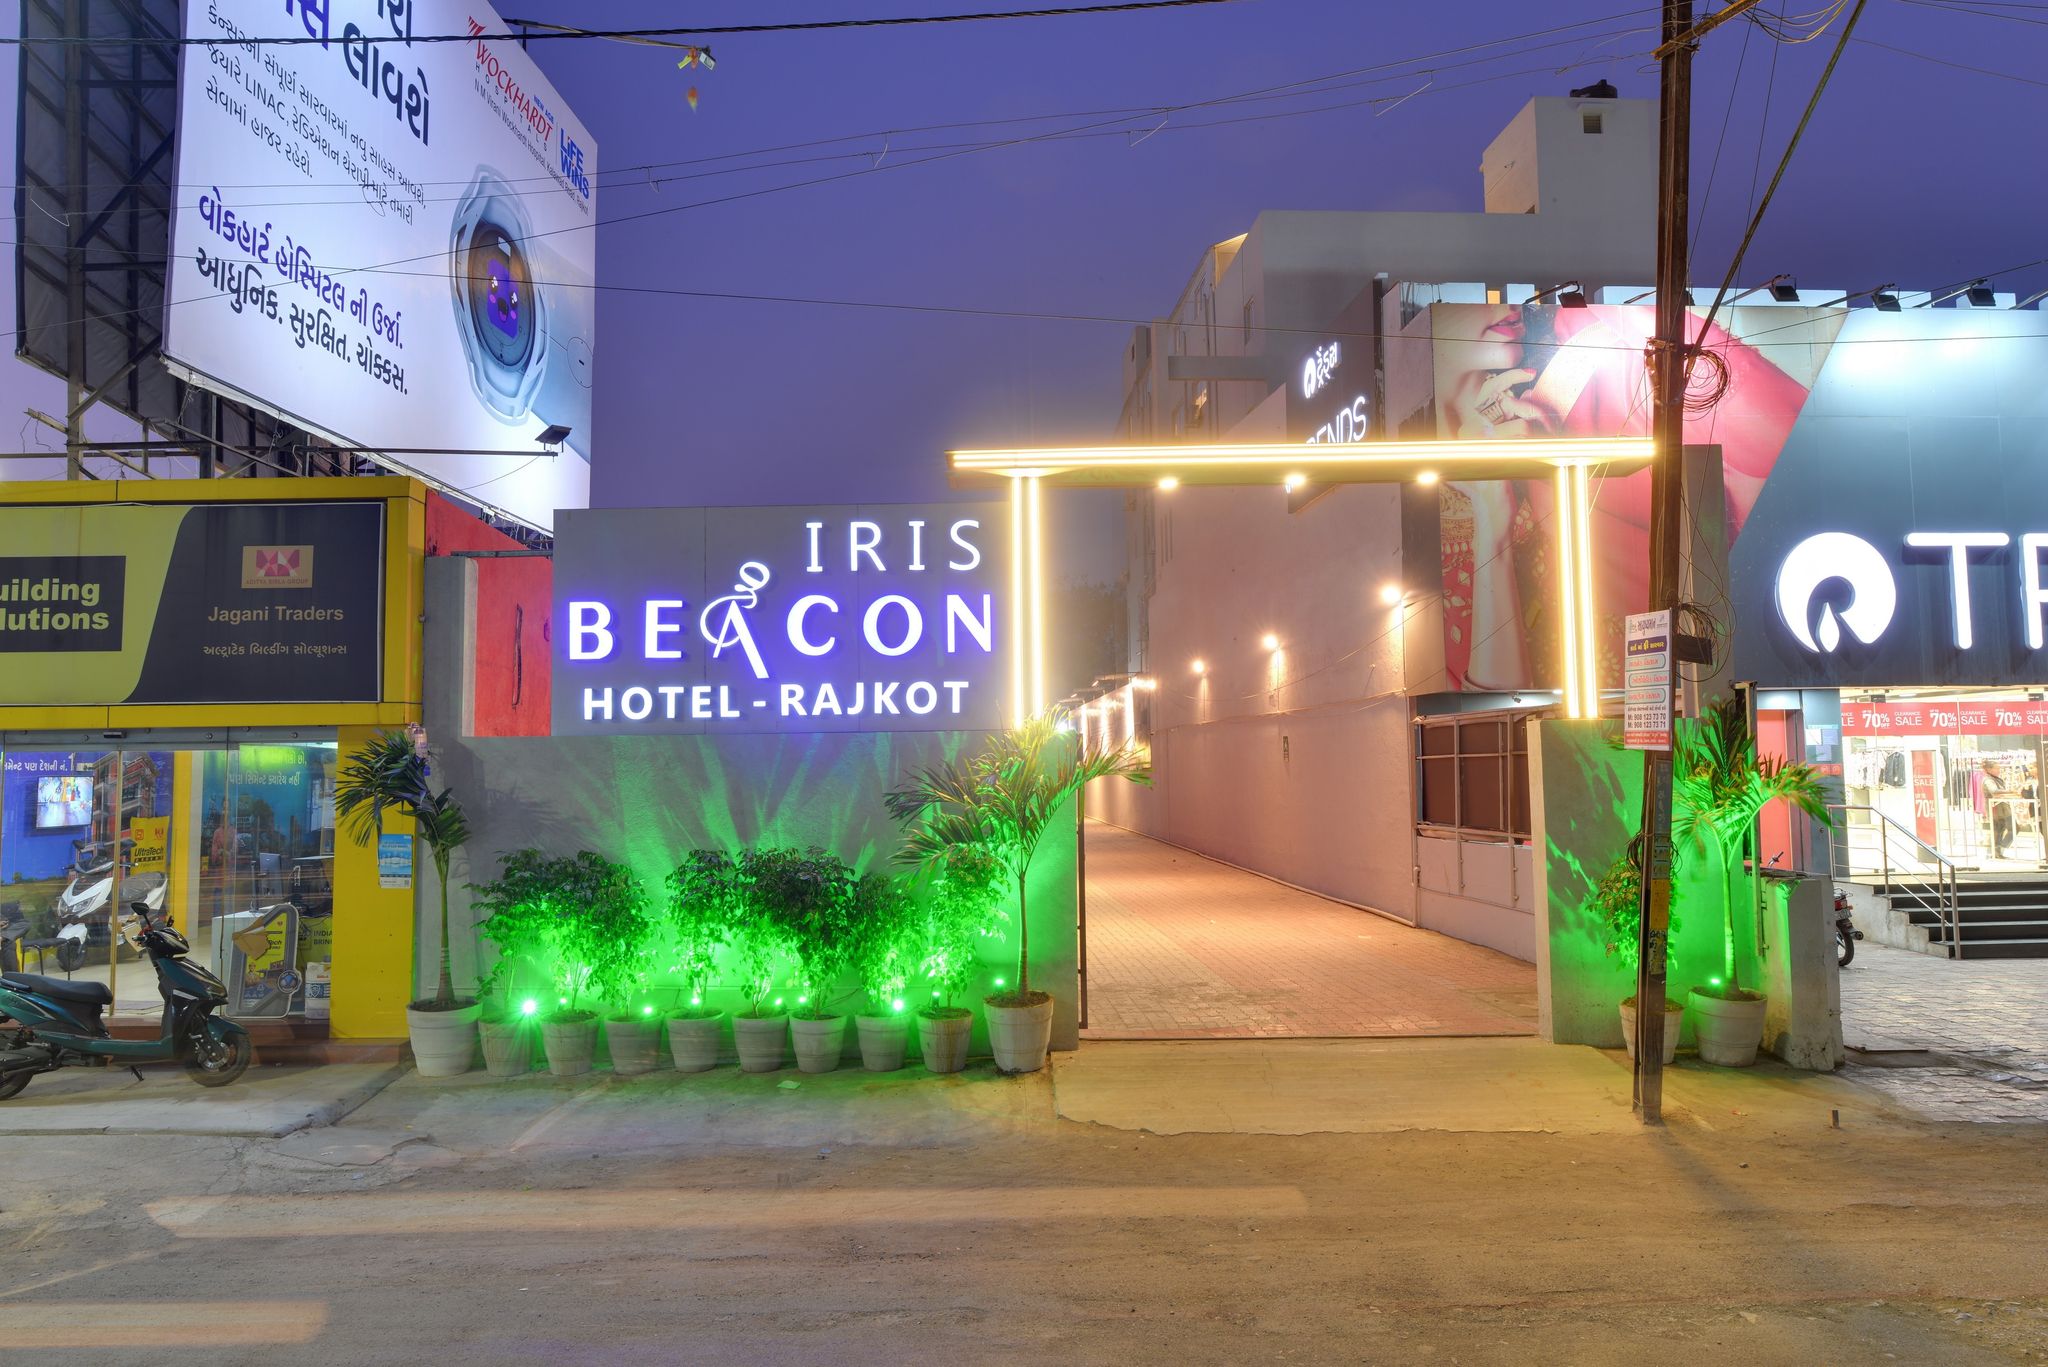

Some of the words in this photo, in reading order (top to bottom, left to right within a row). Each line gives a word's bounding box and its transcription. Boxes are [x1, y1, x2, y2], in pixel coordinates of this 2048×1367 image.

[343, 22, 429, 147] લાવશે
[476, 39, 553, 141] WOCKHARDT
[251, 118, 281, 153] હાજર
[299, 85, 348, 139] સારવારમાં
[370, 147, 395, 180] સાહસ
[199, 186, 272, 264] વોકહાર્ટ
[275, 235, 345, 312] હોસ્પિટલ
[350, 288, 367, 326] ની
[805, 519, 981, 573] IRIS
[208, 606, 269, 625] Jagani
[275, 605, 344, 621] Traders
[569, 575, 991, 679] BEACON
[584, 685, 740, 720] HOTEL
[780, 681, 969, 717] RAJKOT
[1930, 712, 1957, 728] 70%
[1995, 711, 2022, 727] 70%
[1895, 716, 1922, 726] SALE
[1960, 715, 1987, 726] SALE
